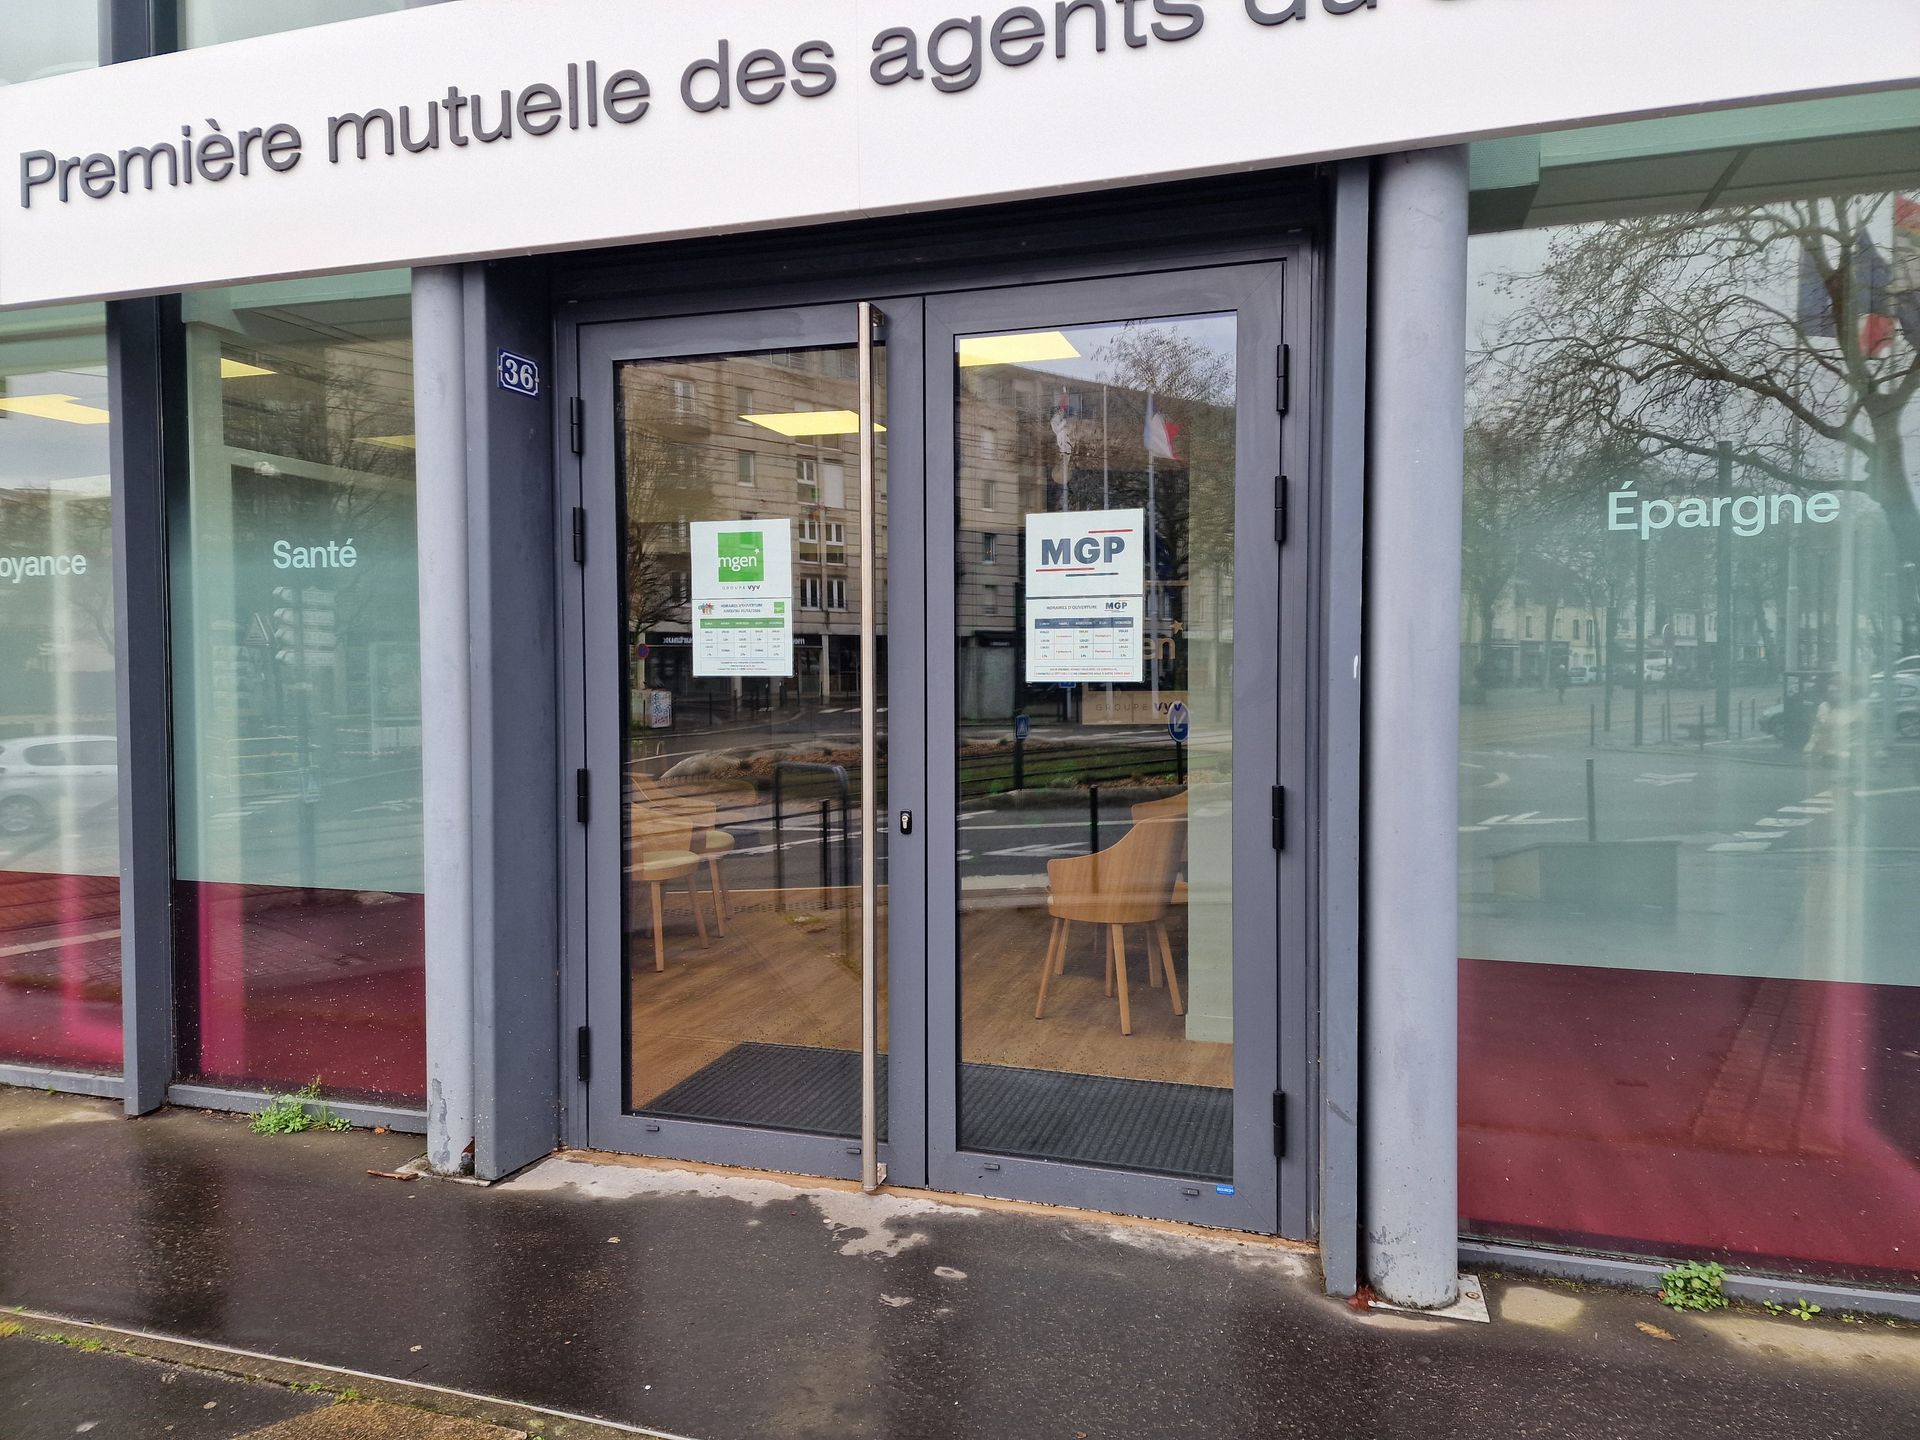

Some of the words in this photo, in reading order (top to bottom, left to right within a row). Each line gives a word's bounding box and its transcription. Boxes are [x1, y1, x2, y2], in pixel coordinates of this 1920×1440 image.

[20, 118, 302, 208] Première
[328, 60, 650, 163] mutuelle
[681, 39, 837, 113] des
[870, 0, 1204, 93] agents
[505, 359, 534, 390] 36
[1608, 480, 1841, 541] Épargne
[273, 538, 357, 569] Santé
[719, 556, 757, 571] mgen
[1041, 536, 1125, 566] MGP
[0, 554, 87, 584] oyance
[1096, 703, 1148, 712] GROUPE
